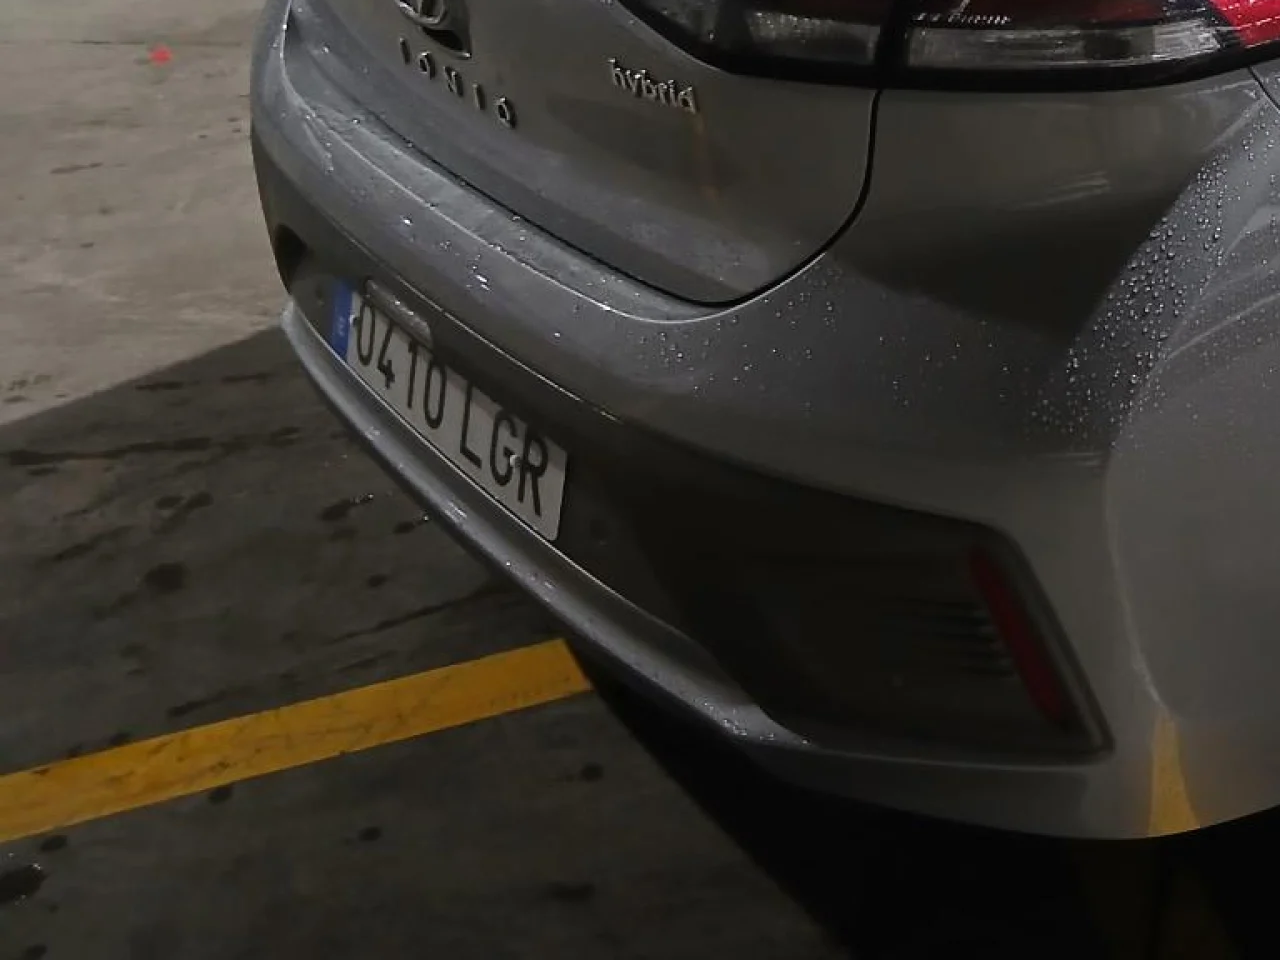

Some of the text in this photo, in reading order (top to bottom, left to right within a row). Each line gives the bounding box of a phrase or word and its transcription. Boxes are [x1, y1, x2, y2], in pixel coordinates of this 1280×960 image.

[607, 57, 697, 115] hybrid
[356, 299, 549, 517] 0410 LGR
